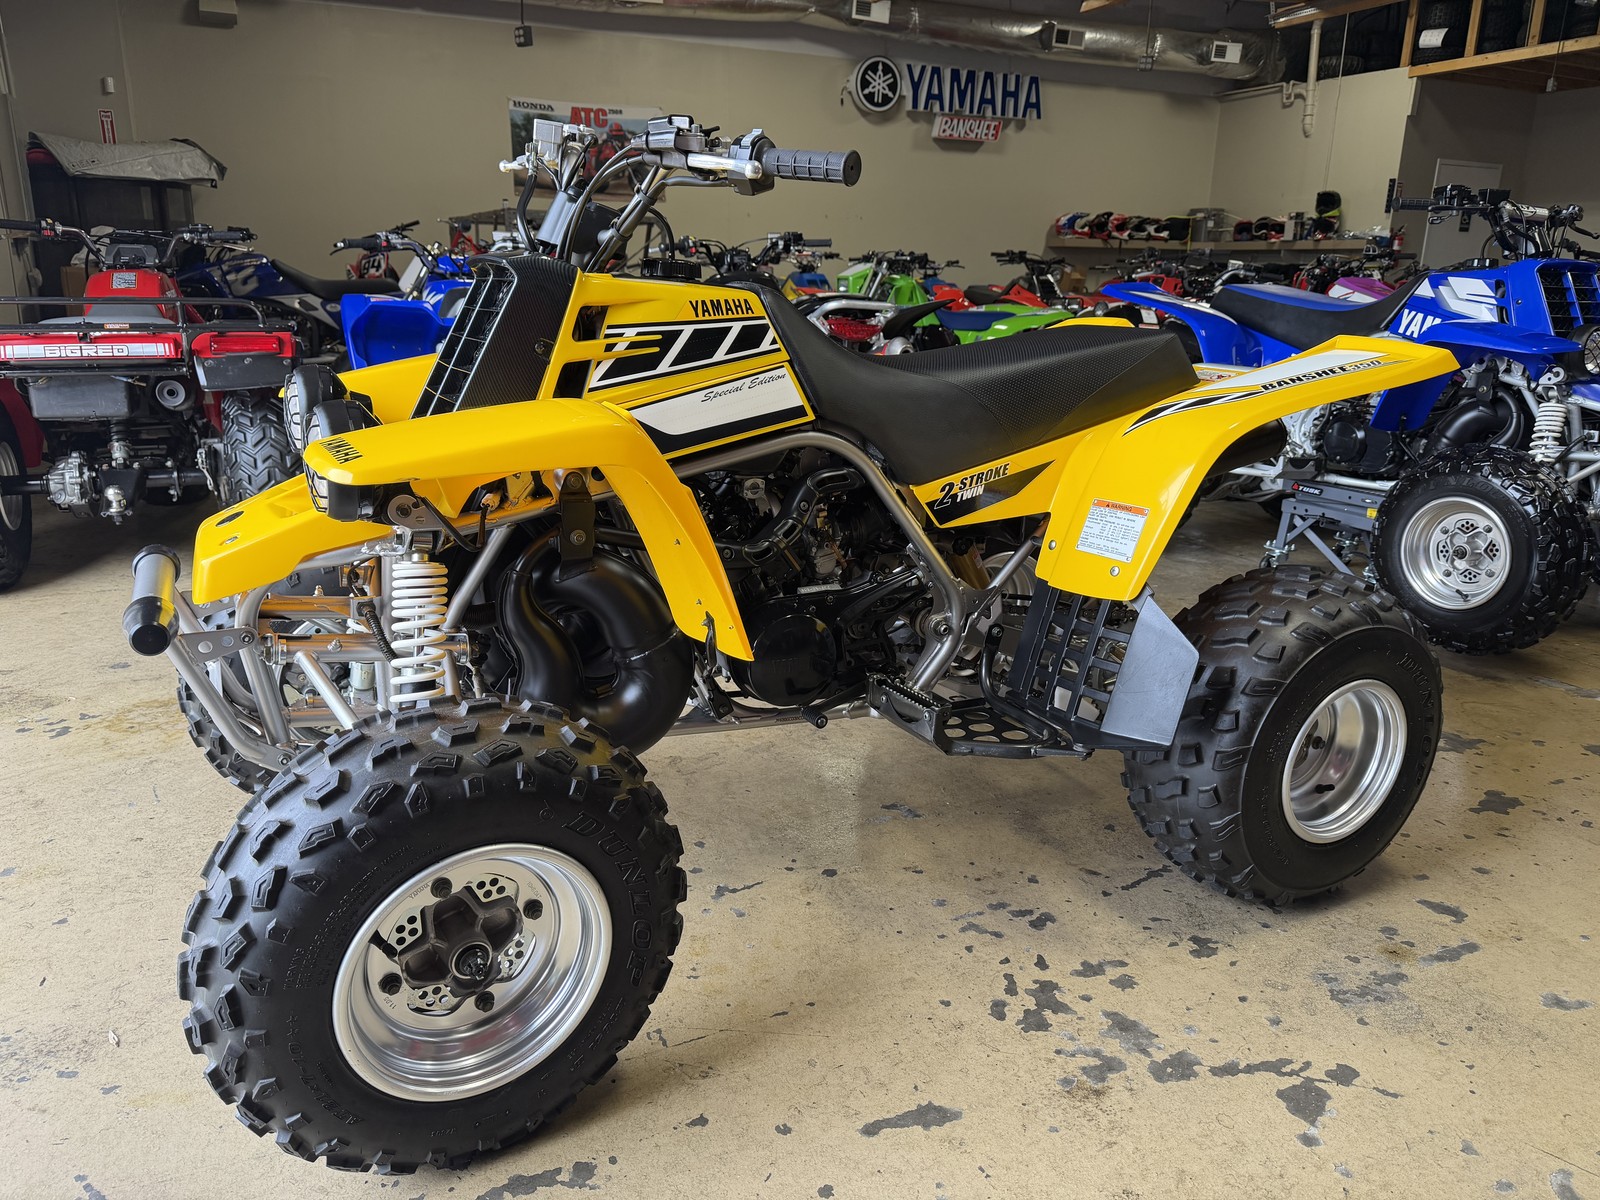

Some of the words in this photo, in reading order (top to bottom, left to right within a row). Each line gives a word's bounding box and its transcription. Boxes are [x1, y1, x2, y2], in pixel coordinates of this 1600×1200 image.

[906, 63, 1042, 120] YAMAHA
[512, 100, 555, 112] HONDA
[569, 106, 608, 128] ATC
[938, 117, 999, 140] BANSHEE
[689, 298, 755, 317] YAMAHA
[1398, 308, 1442, 338] YAM
[701, 382, 744, 403] Special
[748, 373, 787, 390] Edition
[319, 436, 363, 465] YAMAHA
[956, 484, 985, 503] TWIN
[1298, 485, 1321, 495] TUSK
[1110, 502, 1133, 512] WARNING
[561, 809, 653, 988] DUNLOP
